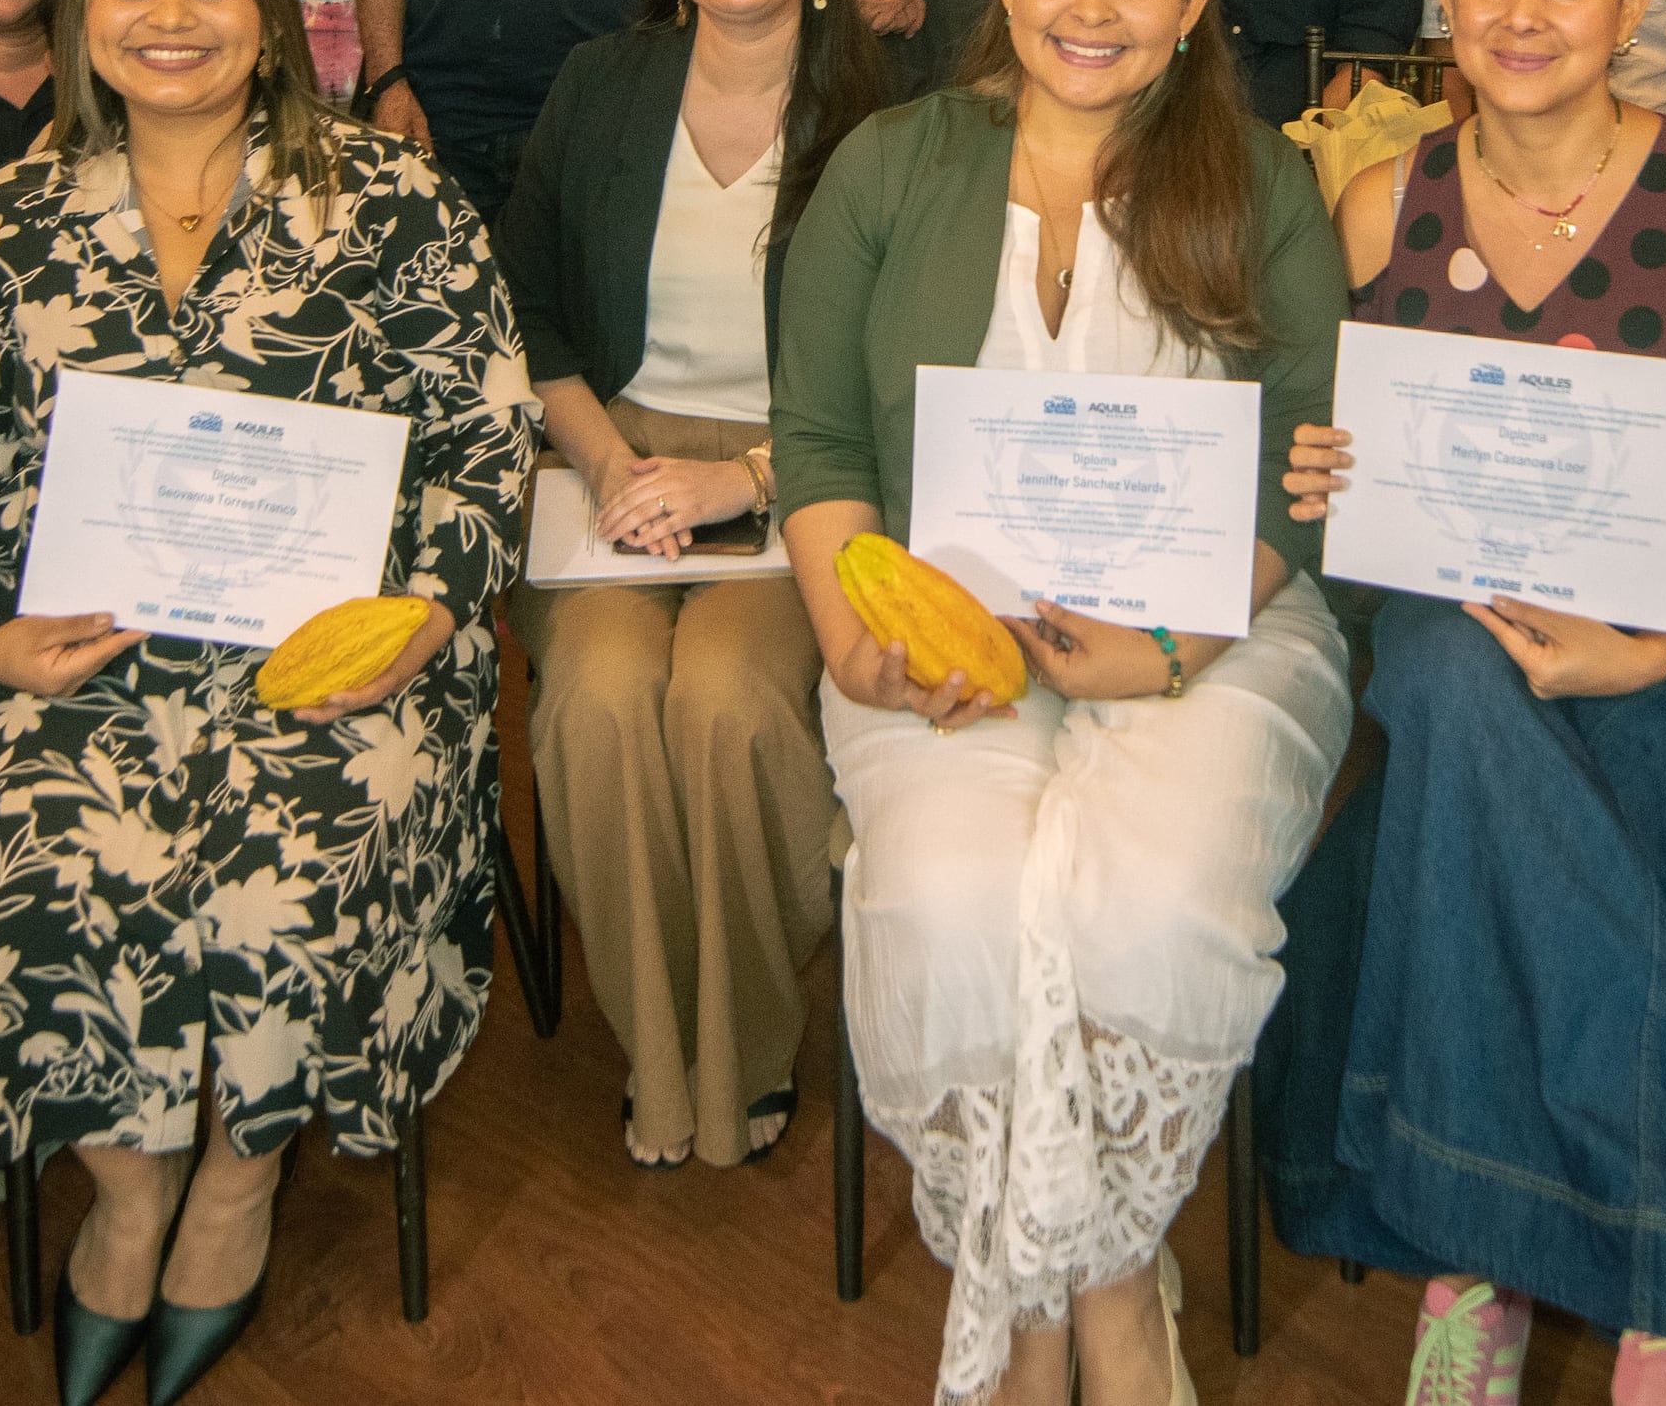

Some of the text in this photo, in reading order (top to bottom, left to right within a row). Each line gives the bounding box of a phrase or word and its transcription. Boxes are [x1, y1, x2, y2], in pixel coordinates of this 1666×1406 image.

[1088, 402, 1137, 414] AQUILES
[1498, 425, 1547, 444] Diploma
[1073, 452, 1117, 467] Diploma
[1494, 450, 1555, 469] Casanova
[1123, 478, 1166, 493] Velarde
